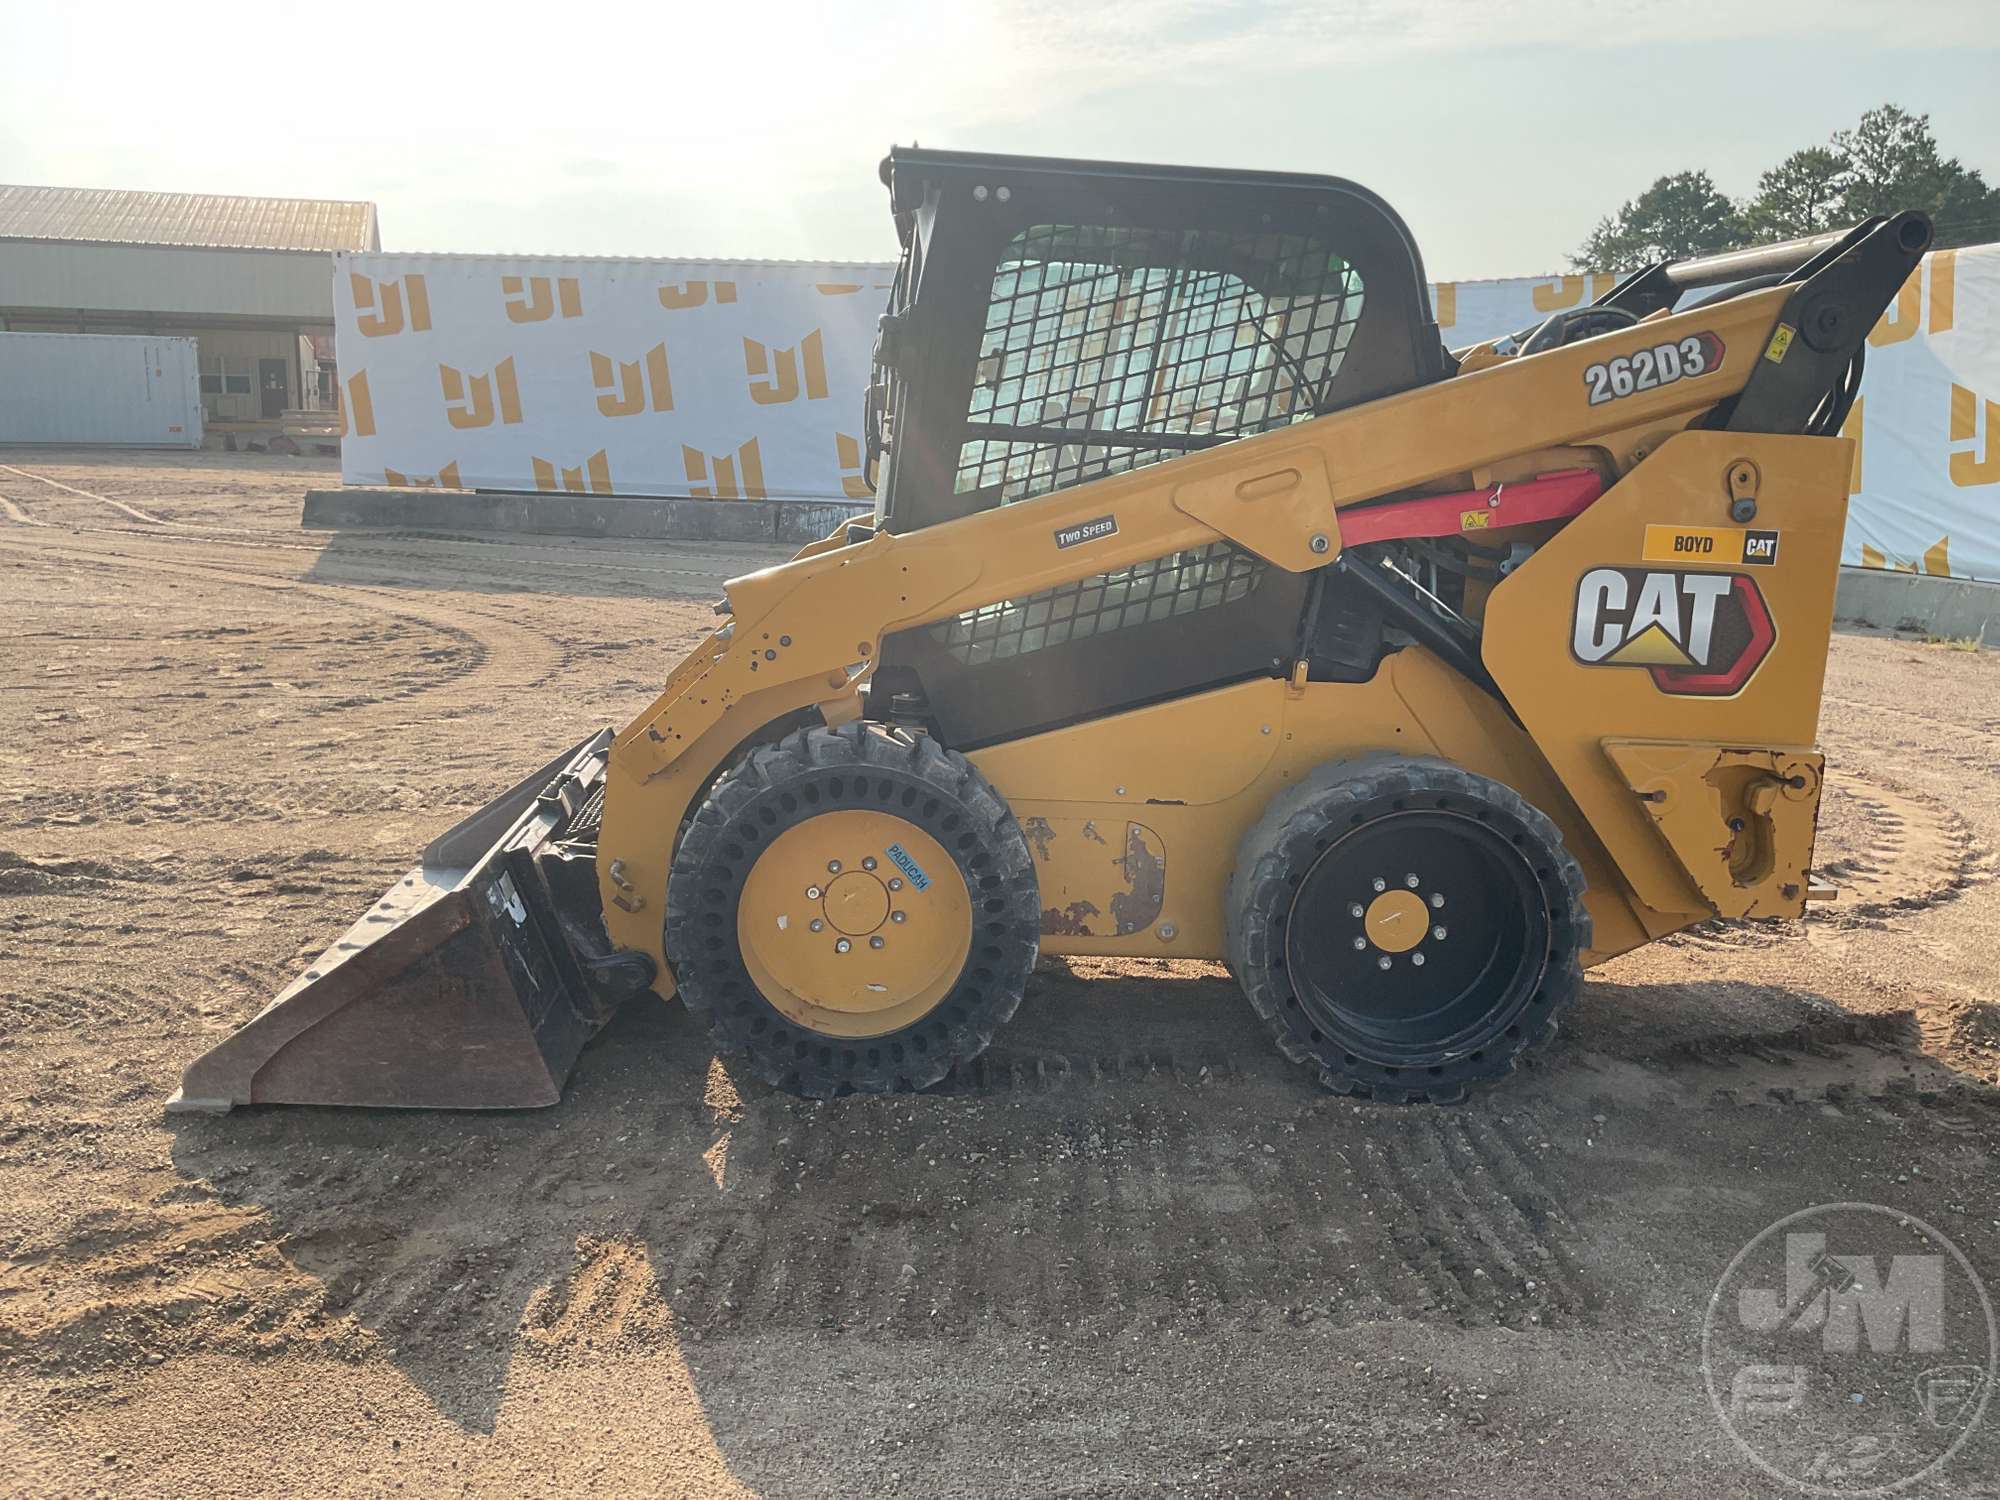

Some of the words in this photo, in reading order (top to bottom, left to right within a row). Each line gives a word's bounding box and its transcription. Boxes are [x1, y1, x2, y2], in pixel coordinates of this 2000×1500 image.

[1585, 337, 1704, 405] 262D3
[1674, 535, 1713, 553] BOYD
[1746, 538, 1774, 557] CAT
[1574, 569, 1731, 666] CAT
[887, 844, 928, 889] PADUCAH
